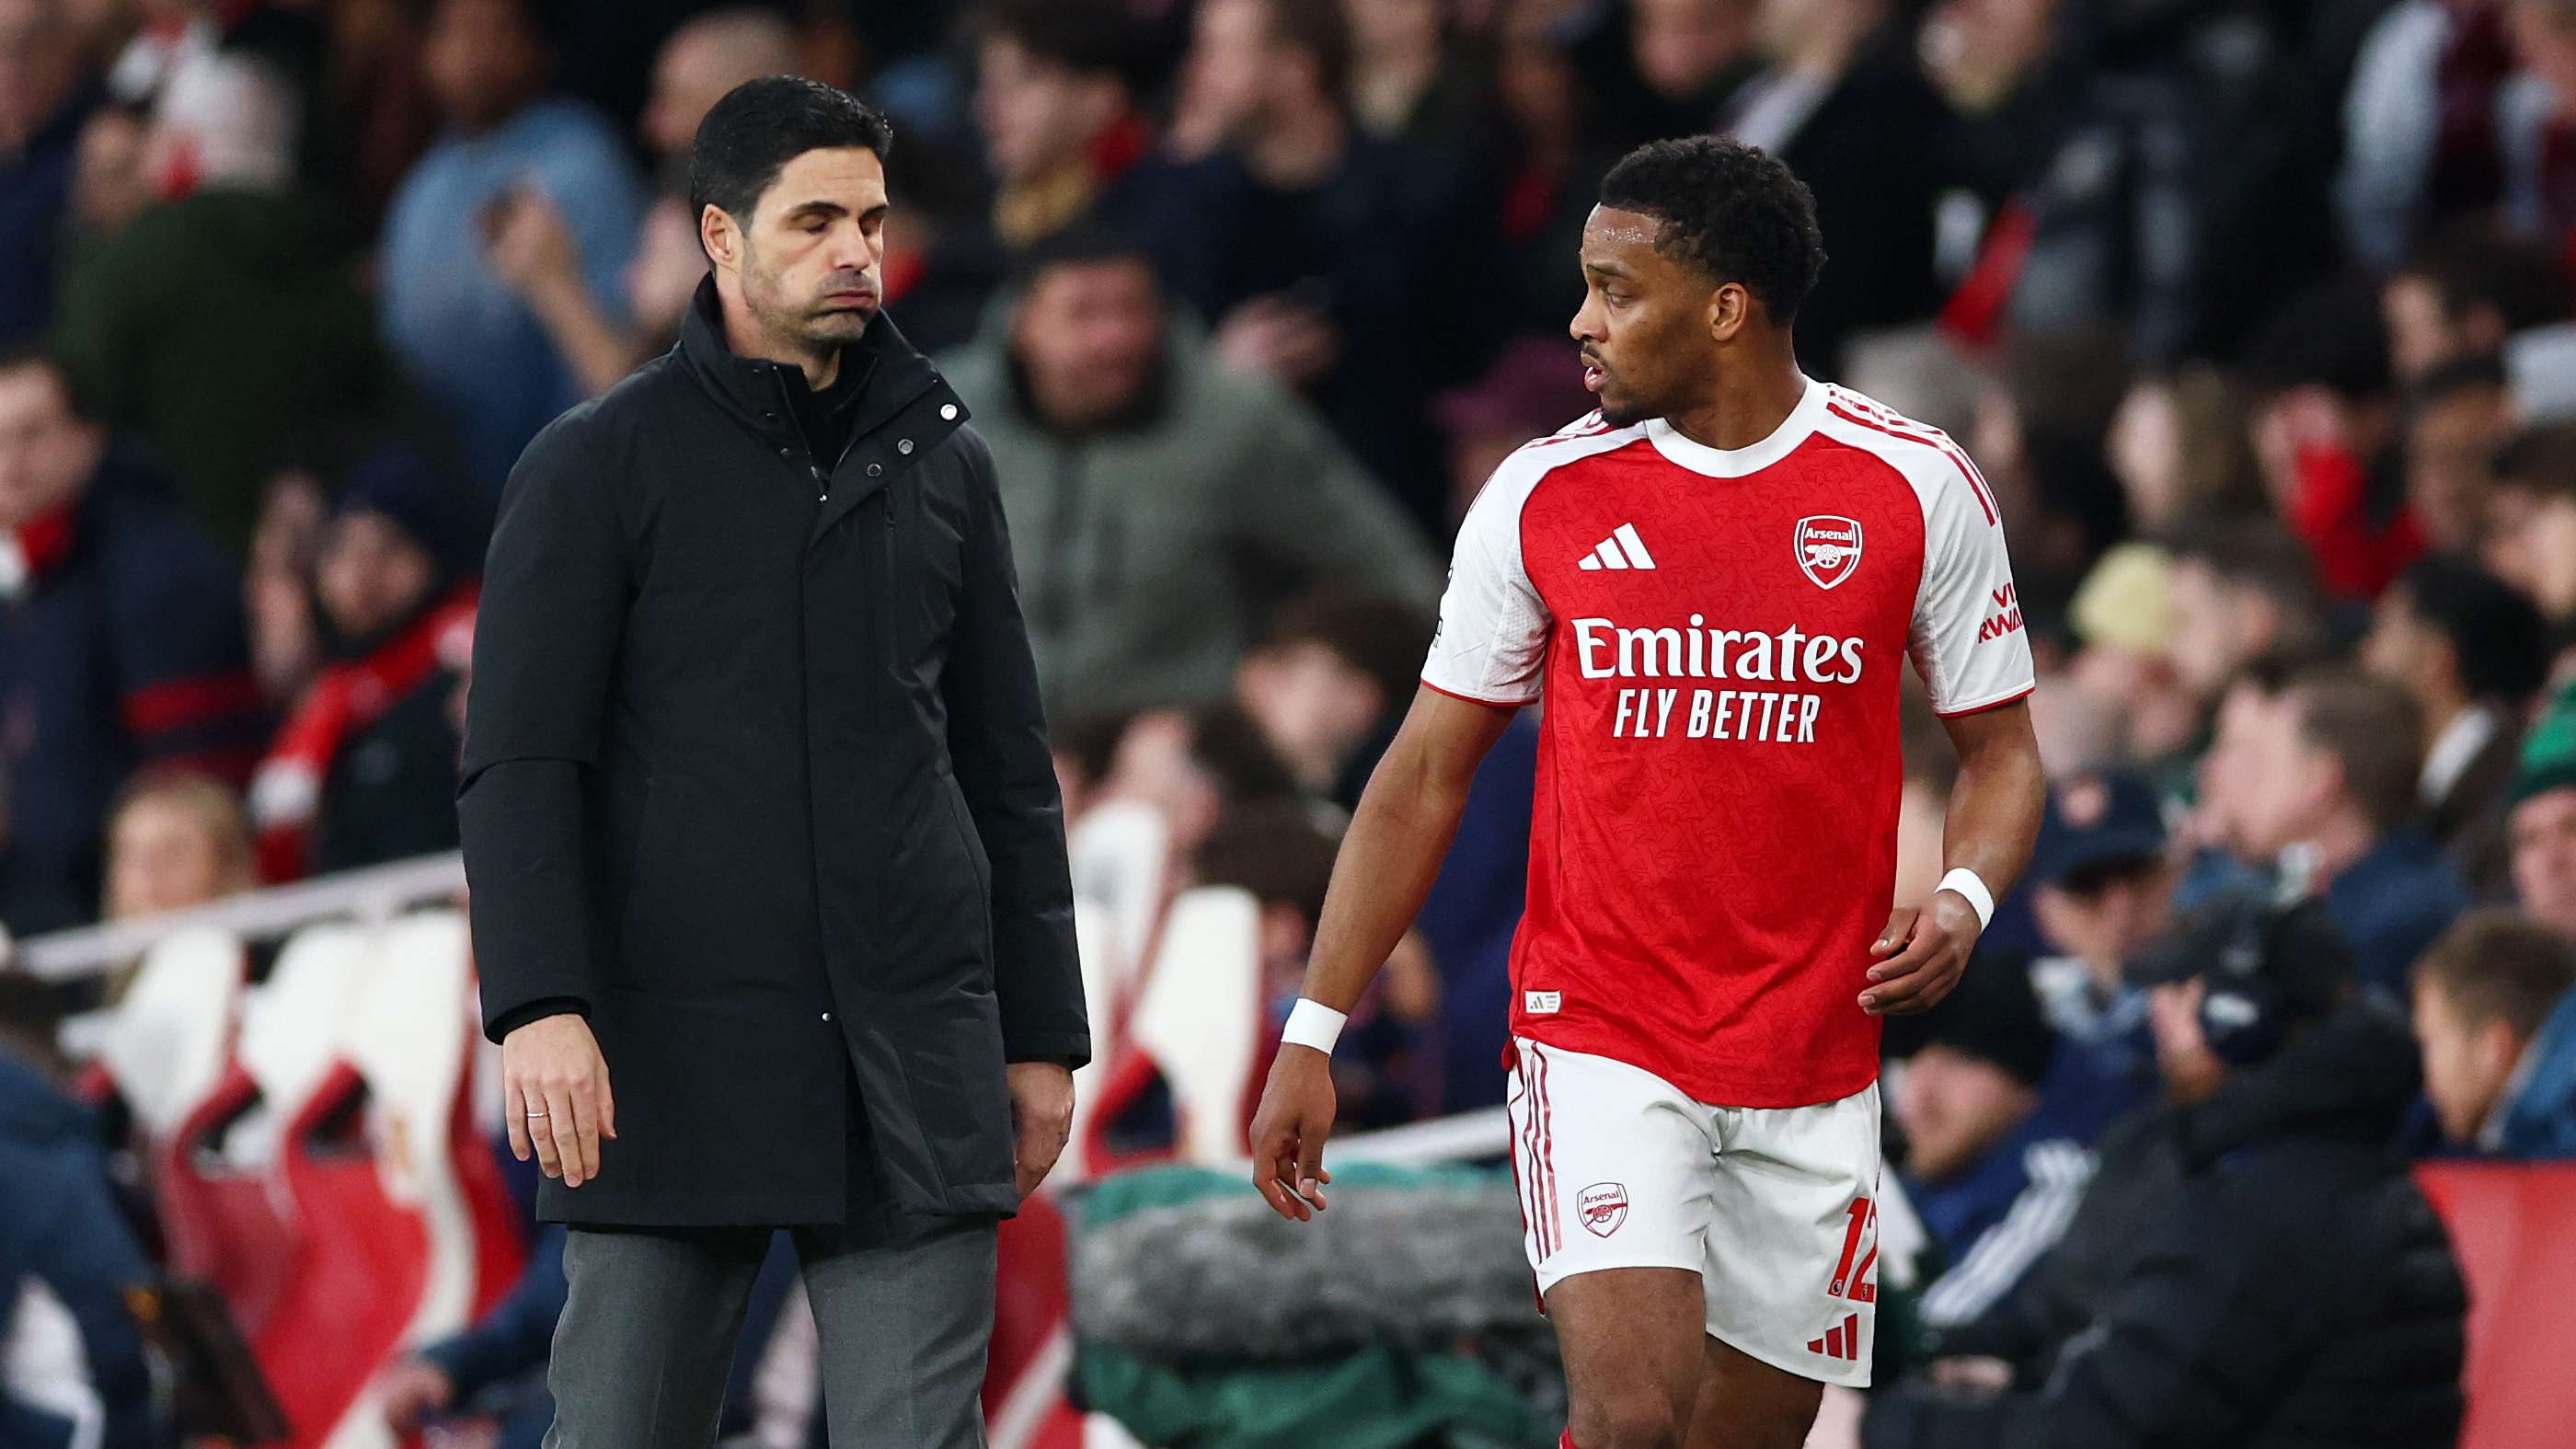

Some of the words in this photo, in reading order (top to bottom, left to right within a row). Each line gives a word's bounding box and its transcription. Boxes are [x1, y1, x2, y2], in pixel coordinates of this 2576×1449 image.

[1804, 527, 1853, 541] Arsenal
[1570, 614, 1864, 684] Emirates
[1613, 688, 1677, 738] FLY
[1686, 689, 1821, 743] BETTER
[1583, 1190, 1619, 1204] Arsenal
[1827, 1197, 1878, 1304] 12
